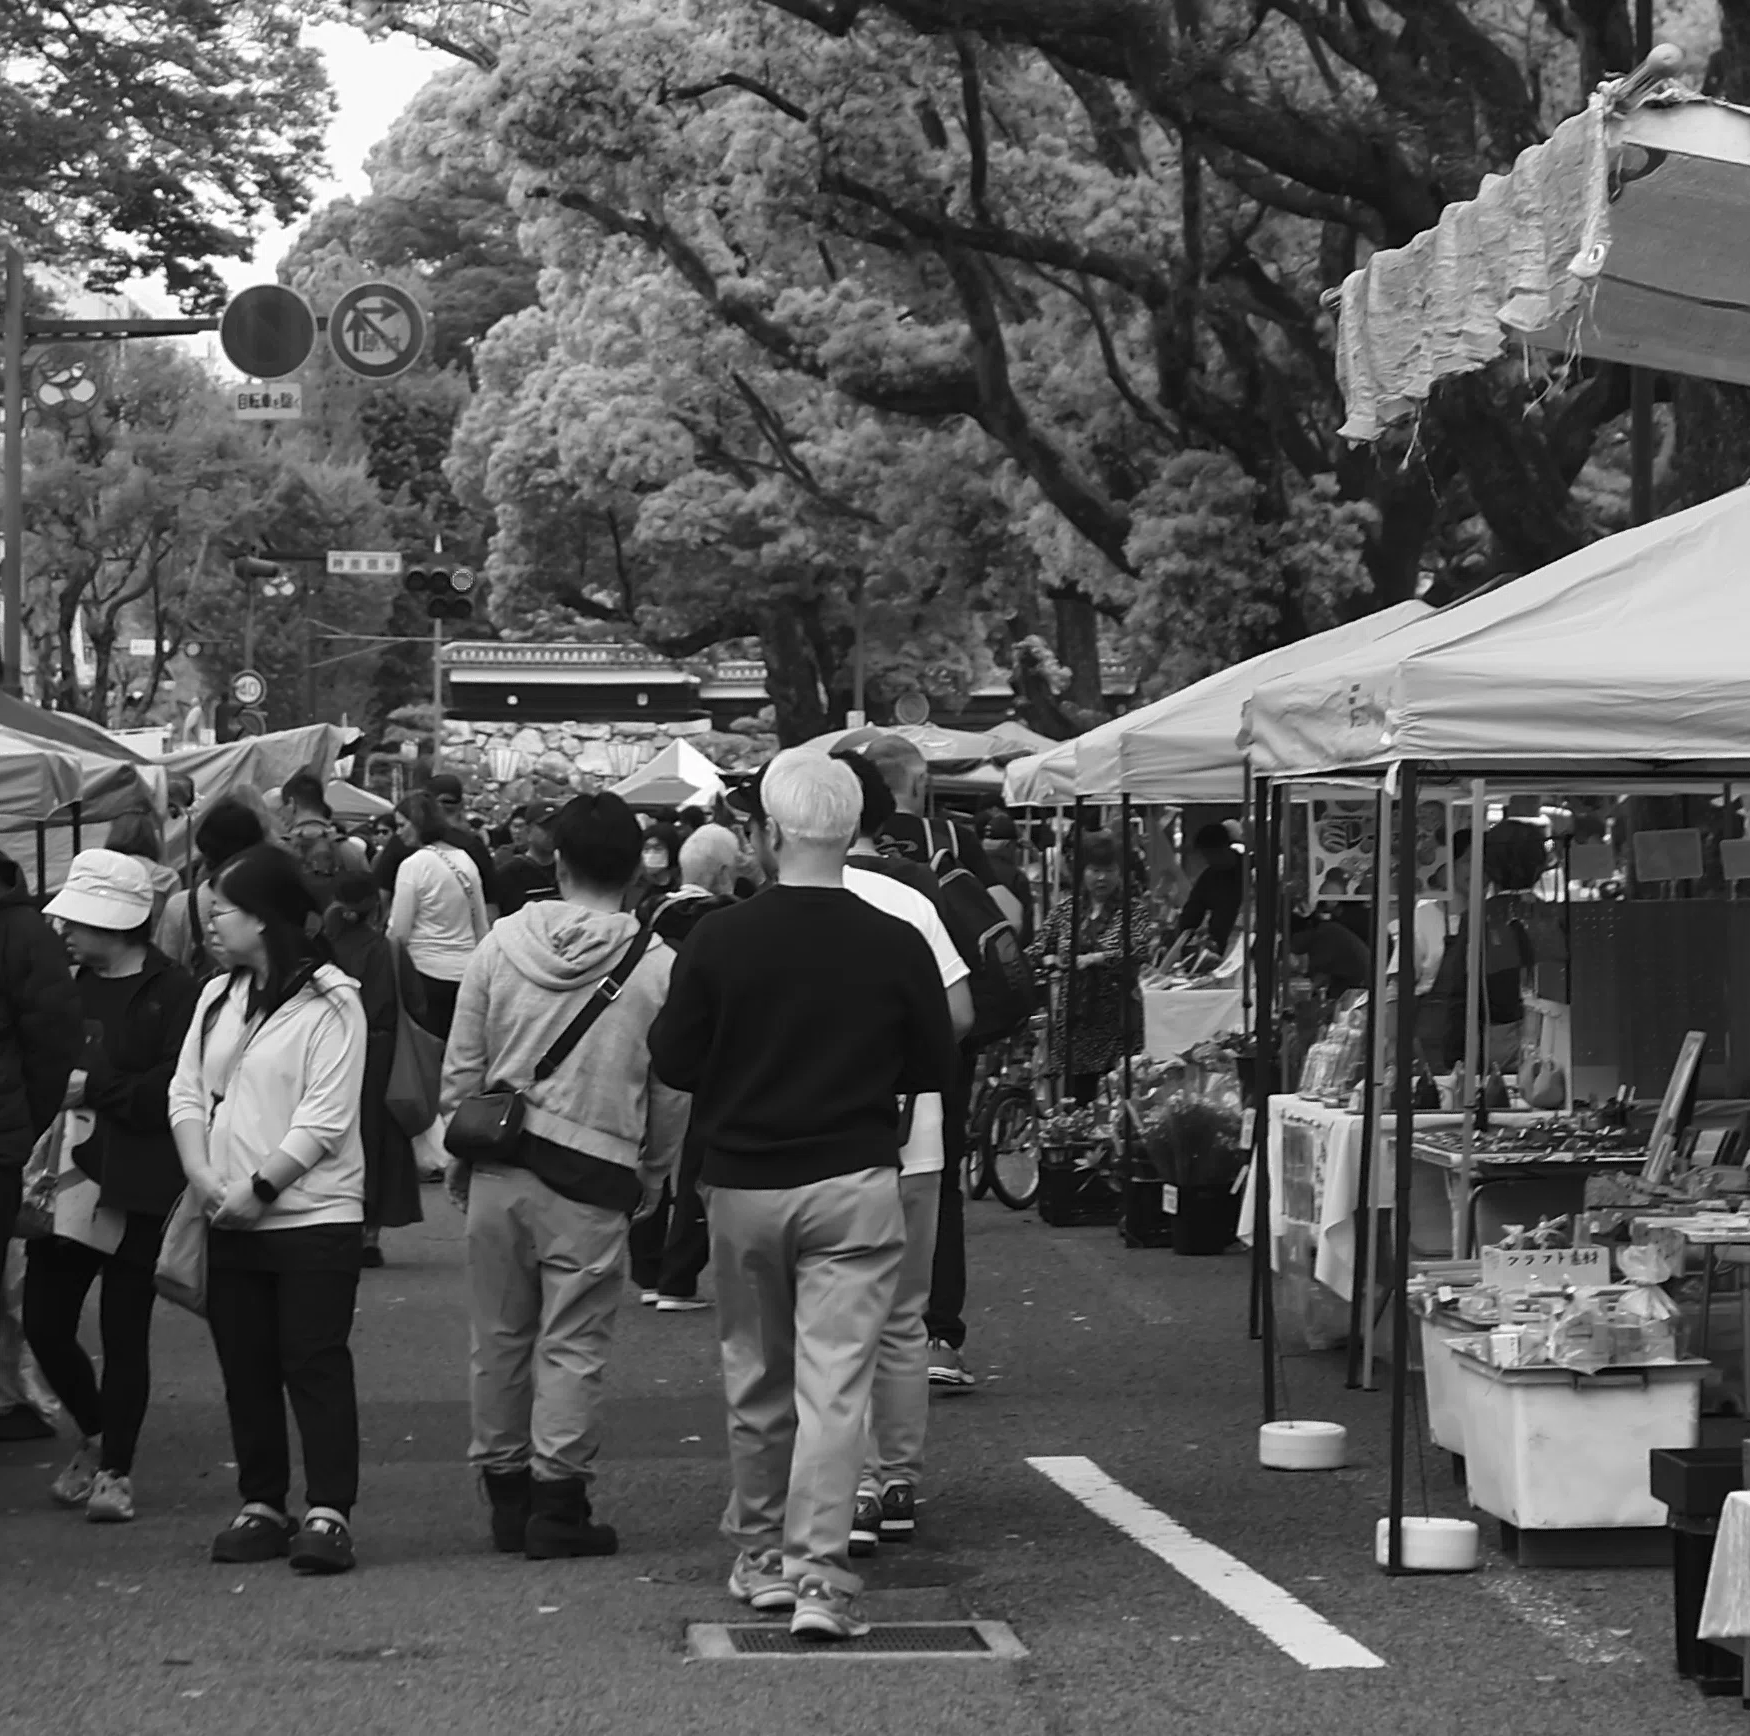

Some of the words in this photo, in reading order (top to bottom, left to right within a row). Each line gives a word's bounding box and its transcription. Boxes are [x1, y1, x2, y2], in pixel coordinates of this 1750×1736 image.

[238, 392, 301, 410] 自転車を除く
